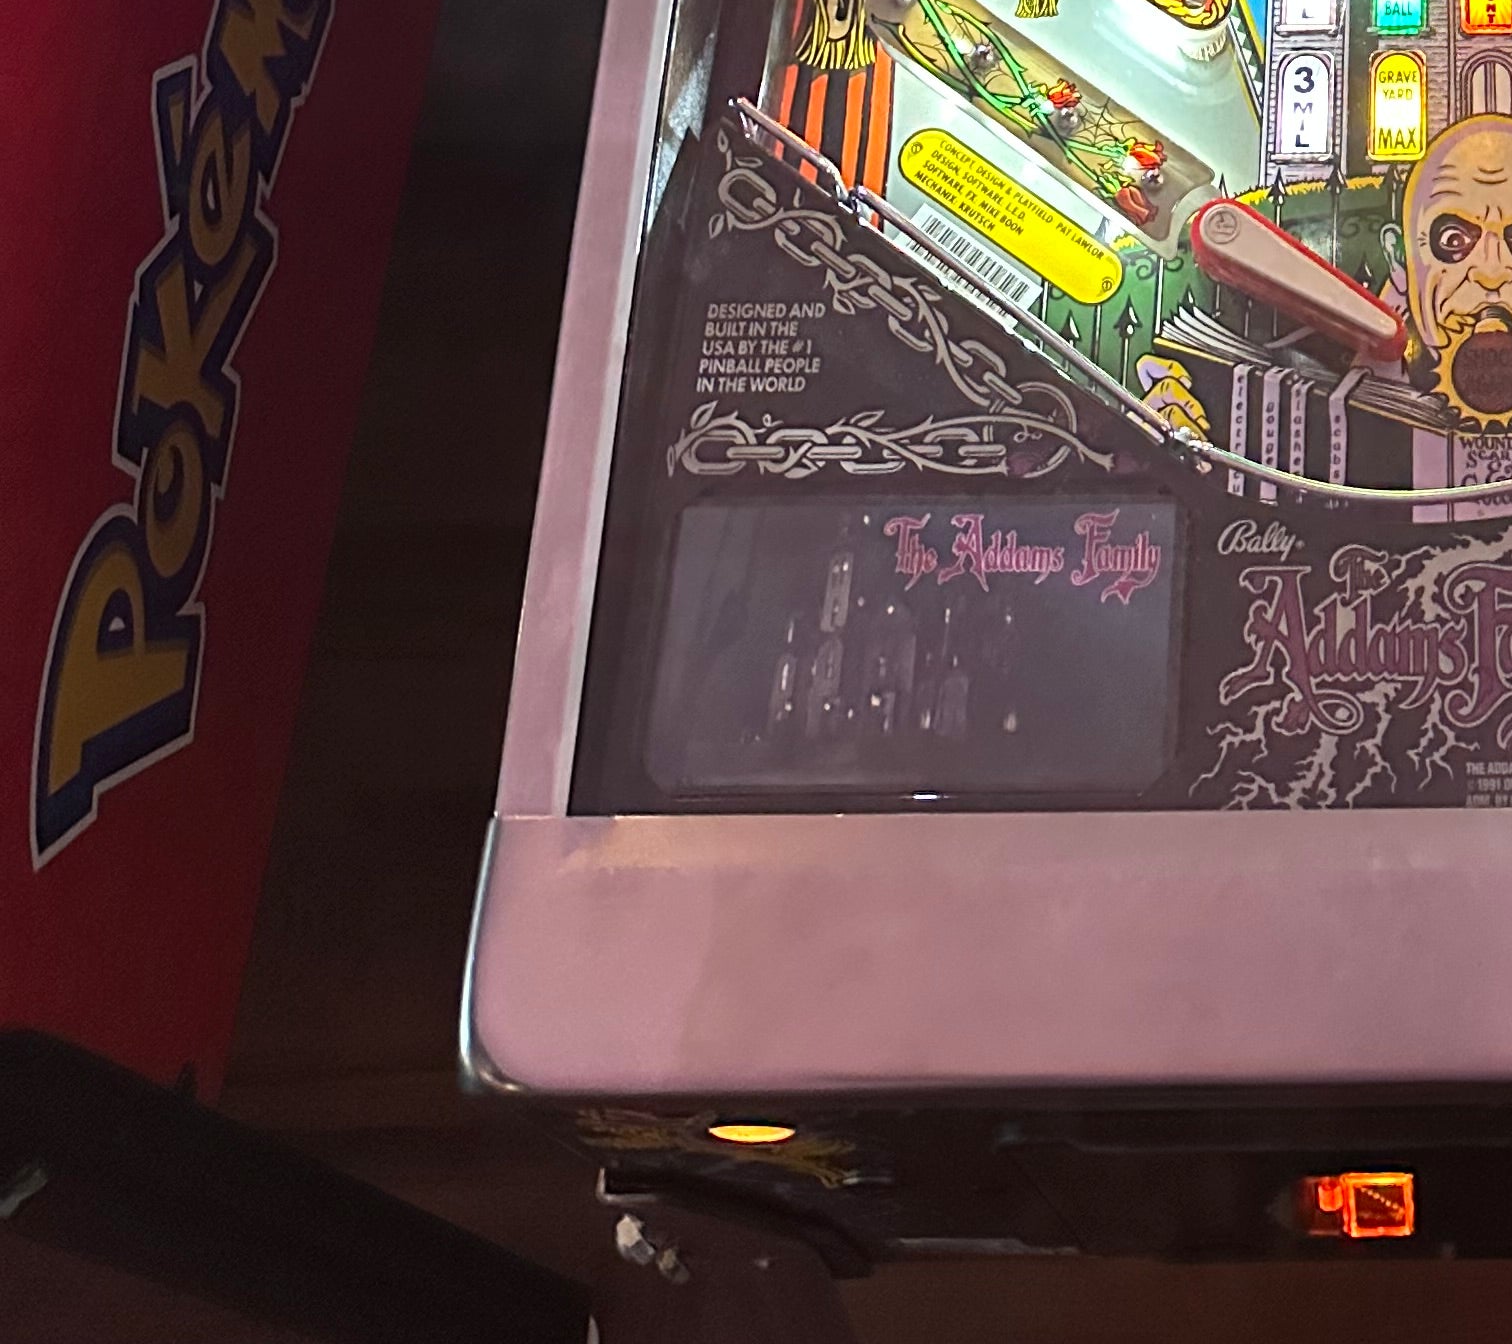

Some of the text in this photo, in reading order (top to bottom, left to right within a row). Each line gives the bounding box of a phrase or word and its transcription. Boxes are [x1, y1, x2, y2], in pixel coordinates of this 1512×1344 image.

[1384, 0, 1413, 17] BALL
[1293, 65, 1316, 94] 3
[1378, 70, 1418, 84] GRAVE
[1382, 88, 1413, 101] YARD
[1378, 126, 1417, 150] MAX
[958, 201, 997, 232] KRUTSCH
[976, 164, 1006, 190] DESIGN
[1013, 190, 1054, 225] PLAYFIELD
[1072, 232, 1105, 261] LAWLOR
[979, 198, 1025, 236] MIKE BOON
[707, 303, 826, 319] DESIGNED AND
[704, 321, 799, 337] BUILT IN THE
[702, 340, 789, 355] USA BY THE
[699, 358, 821, 374] PINBALL PEOPLE
[696, 376, 806, 393] IN THE WORLD
[1217, 518, 1298, 562] Bally
[883, 507, 1162, 605] The Addams Family
[1329, 543, 1391, 605] The
[1219, 565, 1469, 736] Addams
[1466, 762, 1486, 775] THE
